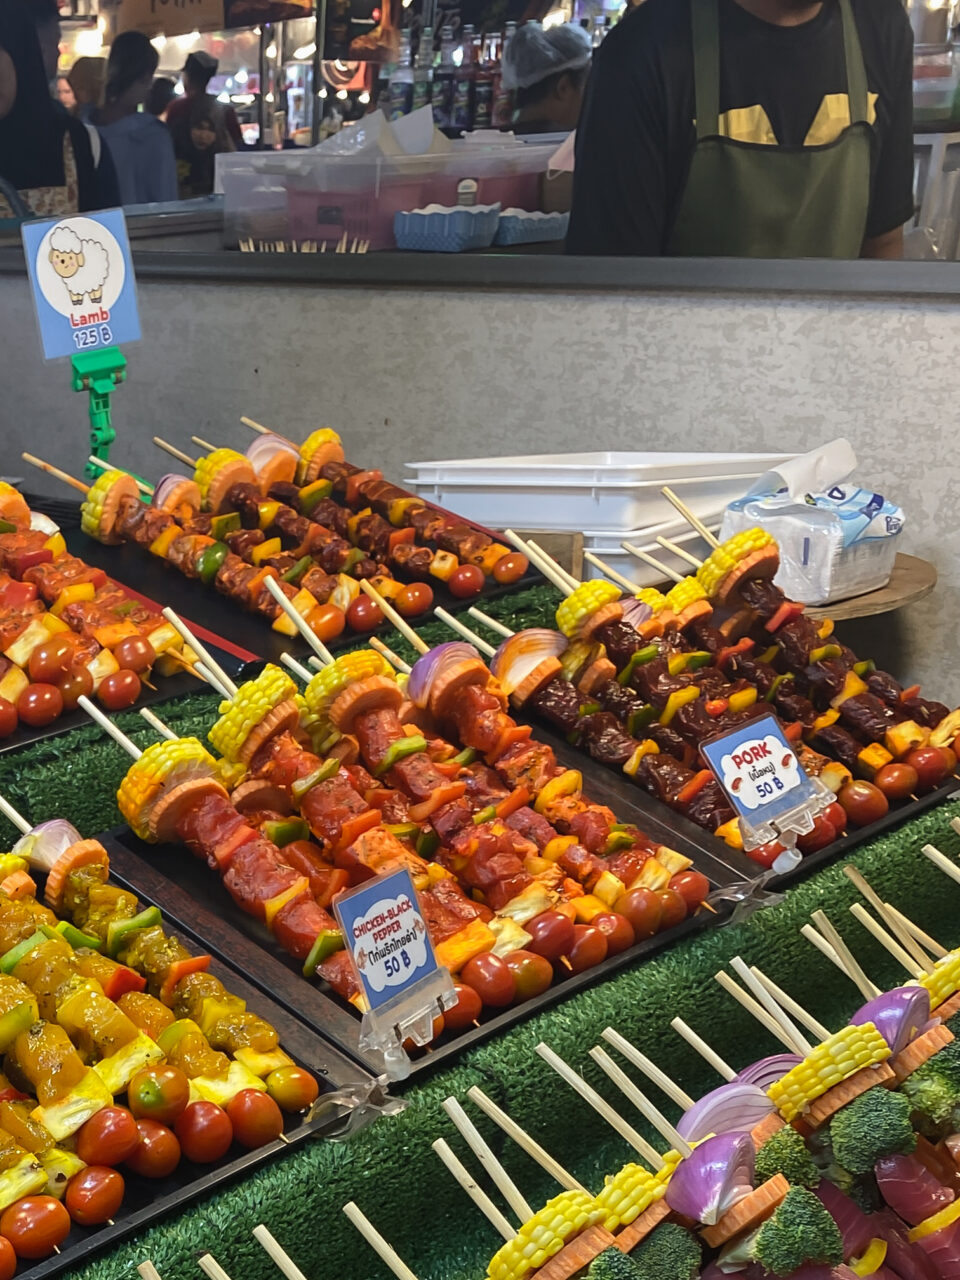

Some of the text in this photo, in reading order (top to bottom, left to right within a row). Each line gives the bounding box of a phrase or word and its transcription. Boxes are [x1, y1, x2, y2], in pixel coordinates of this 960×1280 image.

[70, 302, 109, 328] Lamb
[74, 329, 98, 347] 125
[731, 741, 772, 770] PORK
[755, 781, 774, 798] 50
[353, 899, 413, 939] CHICKEN-BLACK
[372, 920, 402, 944] PEPPER
[384, 956, 401, 978] 50
